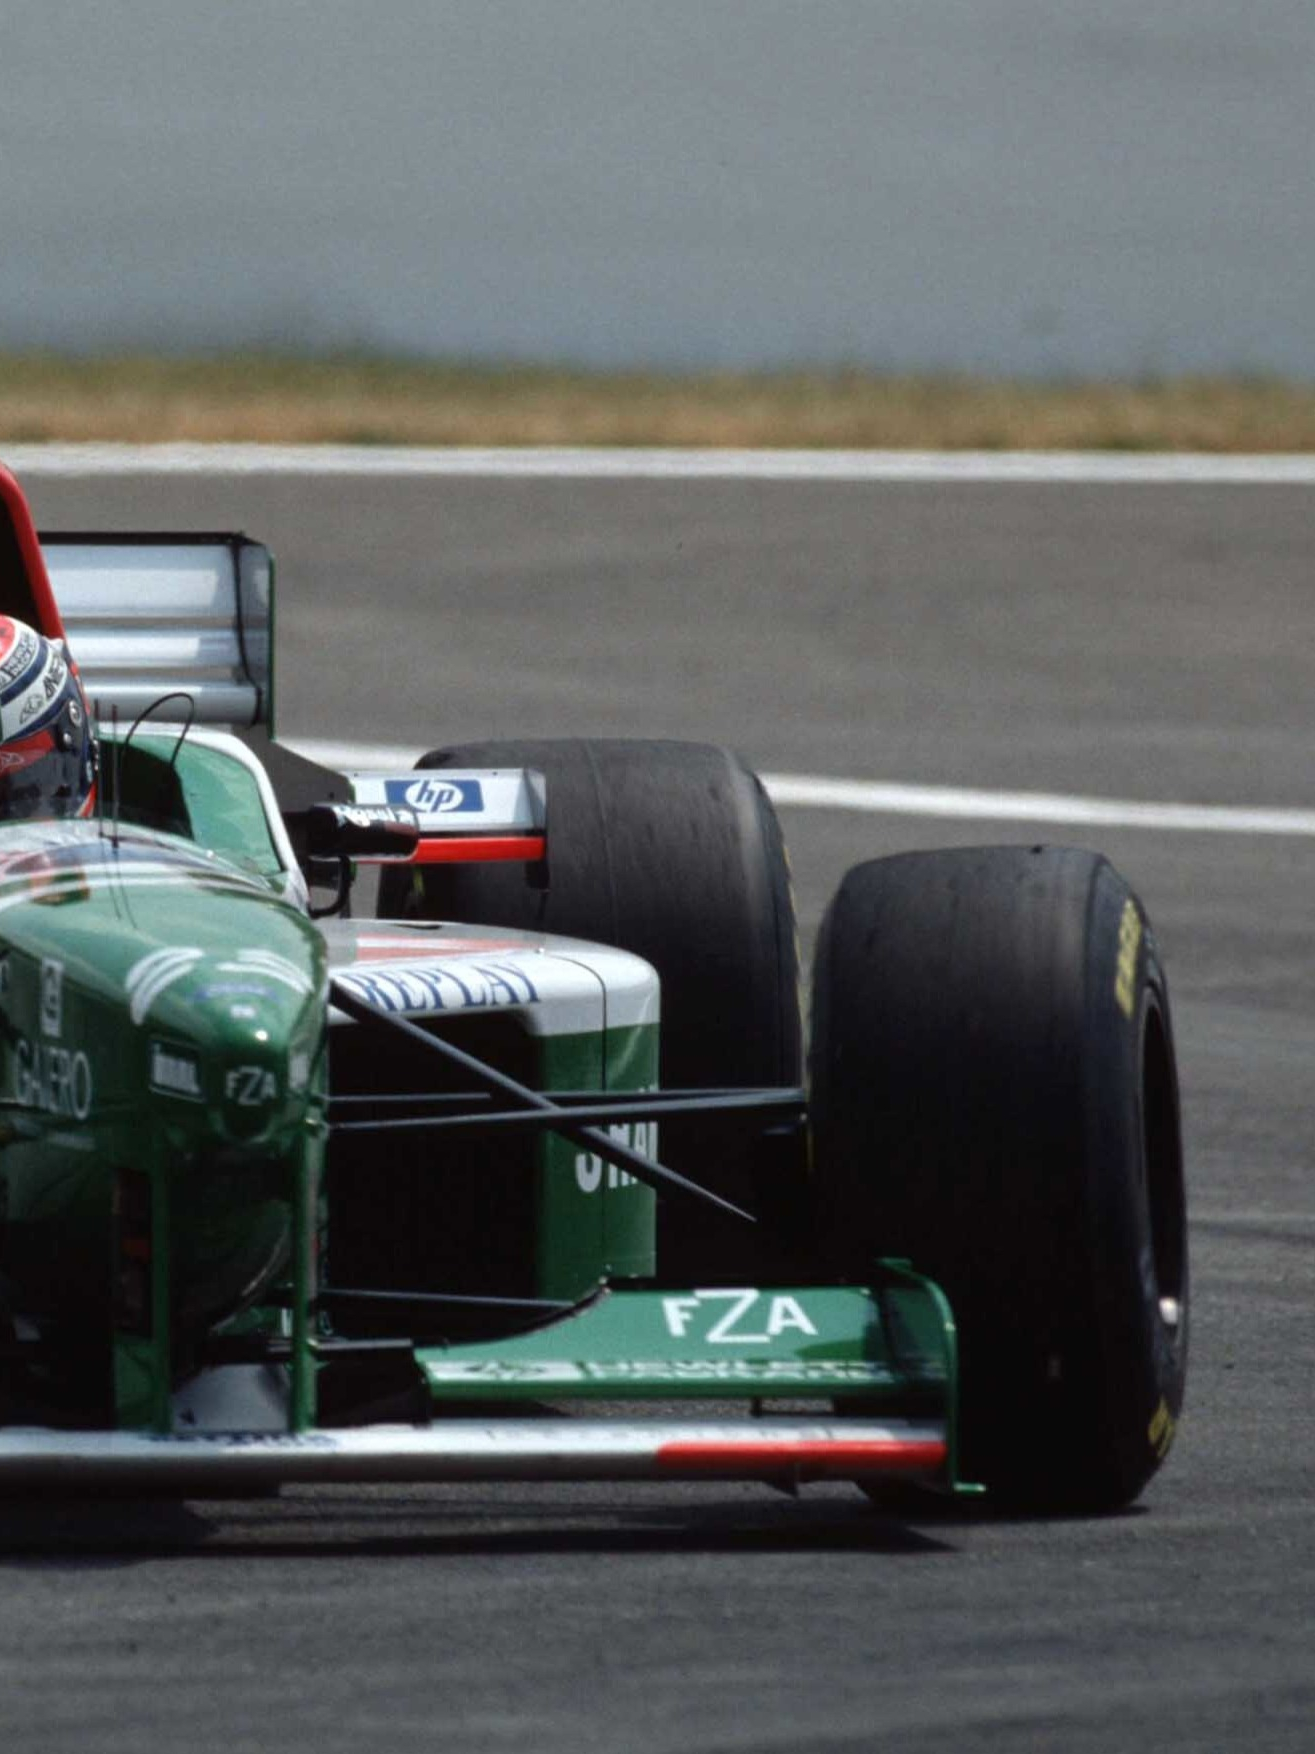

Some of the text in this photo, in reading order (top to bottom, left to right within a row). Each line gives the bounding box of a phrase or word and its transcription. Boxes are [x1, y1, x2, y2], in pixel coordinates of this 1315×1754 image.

[414, 780, 456, 812] hp
[335, 963, 541, 1013] REPLAY
[225, 1065, 277, 1107] FZA
[662, 1288, 819, 1344] FZA
